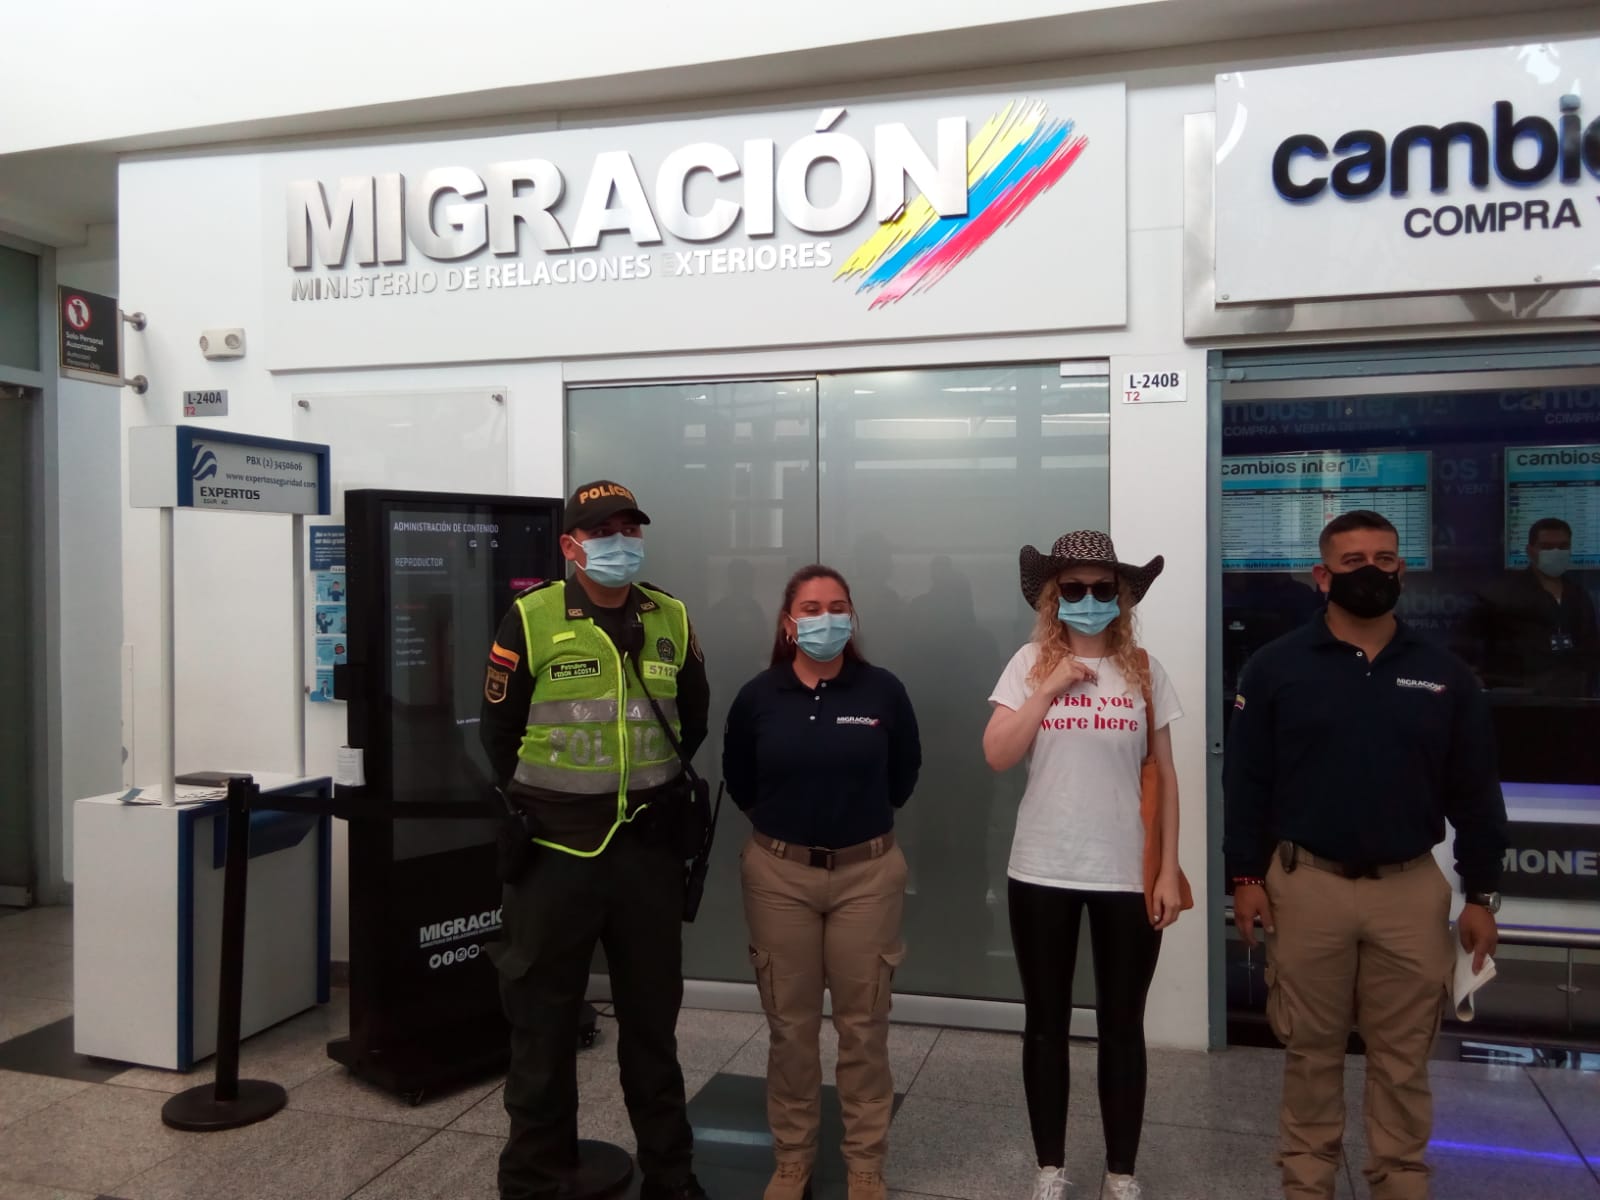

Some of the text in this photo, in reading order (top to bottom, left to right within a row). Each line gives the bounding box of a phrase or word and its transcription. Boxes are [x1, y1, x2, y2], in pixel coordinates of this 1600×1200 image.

[286, 107, 969, 270] MIGRACIÓN
[1404, 198, 1581, 238] COMPRA
[291, 269, 438, 301] MINISTERIO
[445, 266, 480, 292] DE
[486, 253, 651, 288] RELACIONES
[1129, 372, 1179, 389] L-240B
[187, 391, 222, 405] L-240A
[1124, 391, 1140, 402] T2
[184, 406, 196, 416] T2
[246, 455, 262, 467] PBX
[200, 486, 261, 500] EXPERTOS
[393, 520, 499, 533] ADMINISTRACIÓN DE CONTENIDO
[395, 557, 444, 568] REPRODUCTOR
[1097, 696, 1134, 711] you
[1041, 713, 1139, 732] were here
[1502, 848, 1600, 876] MONE
